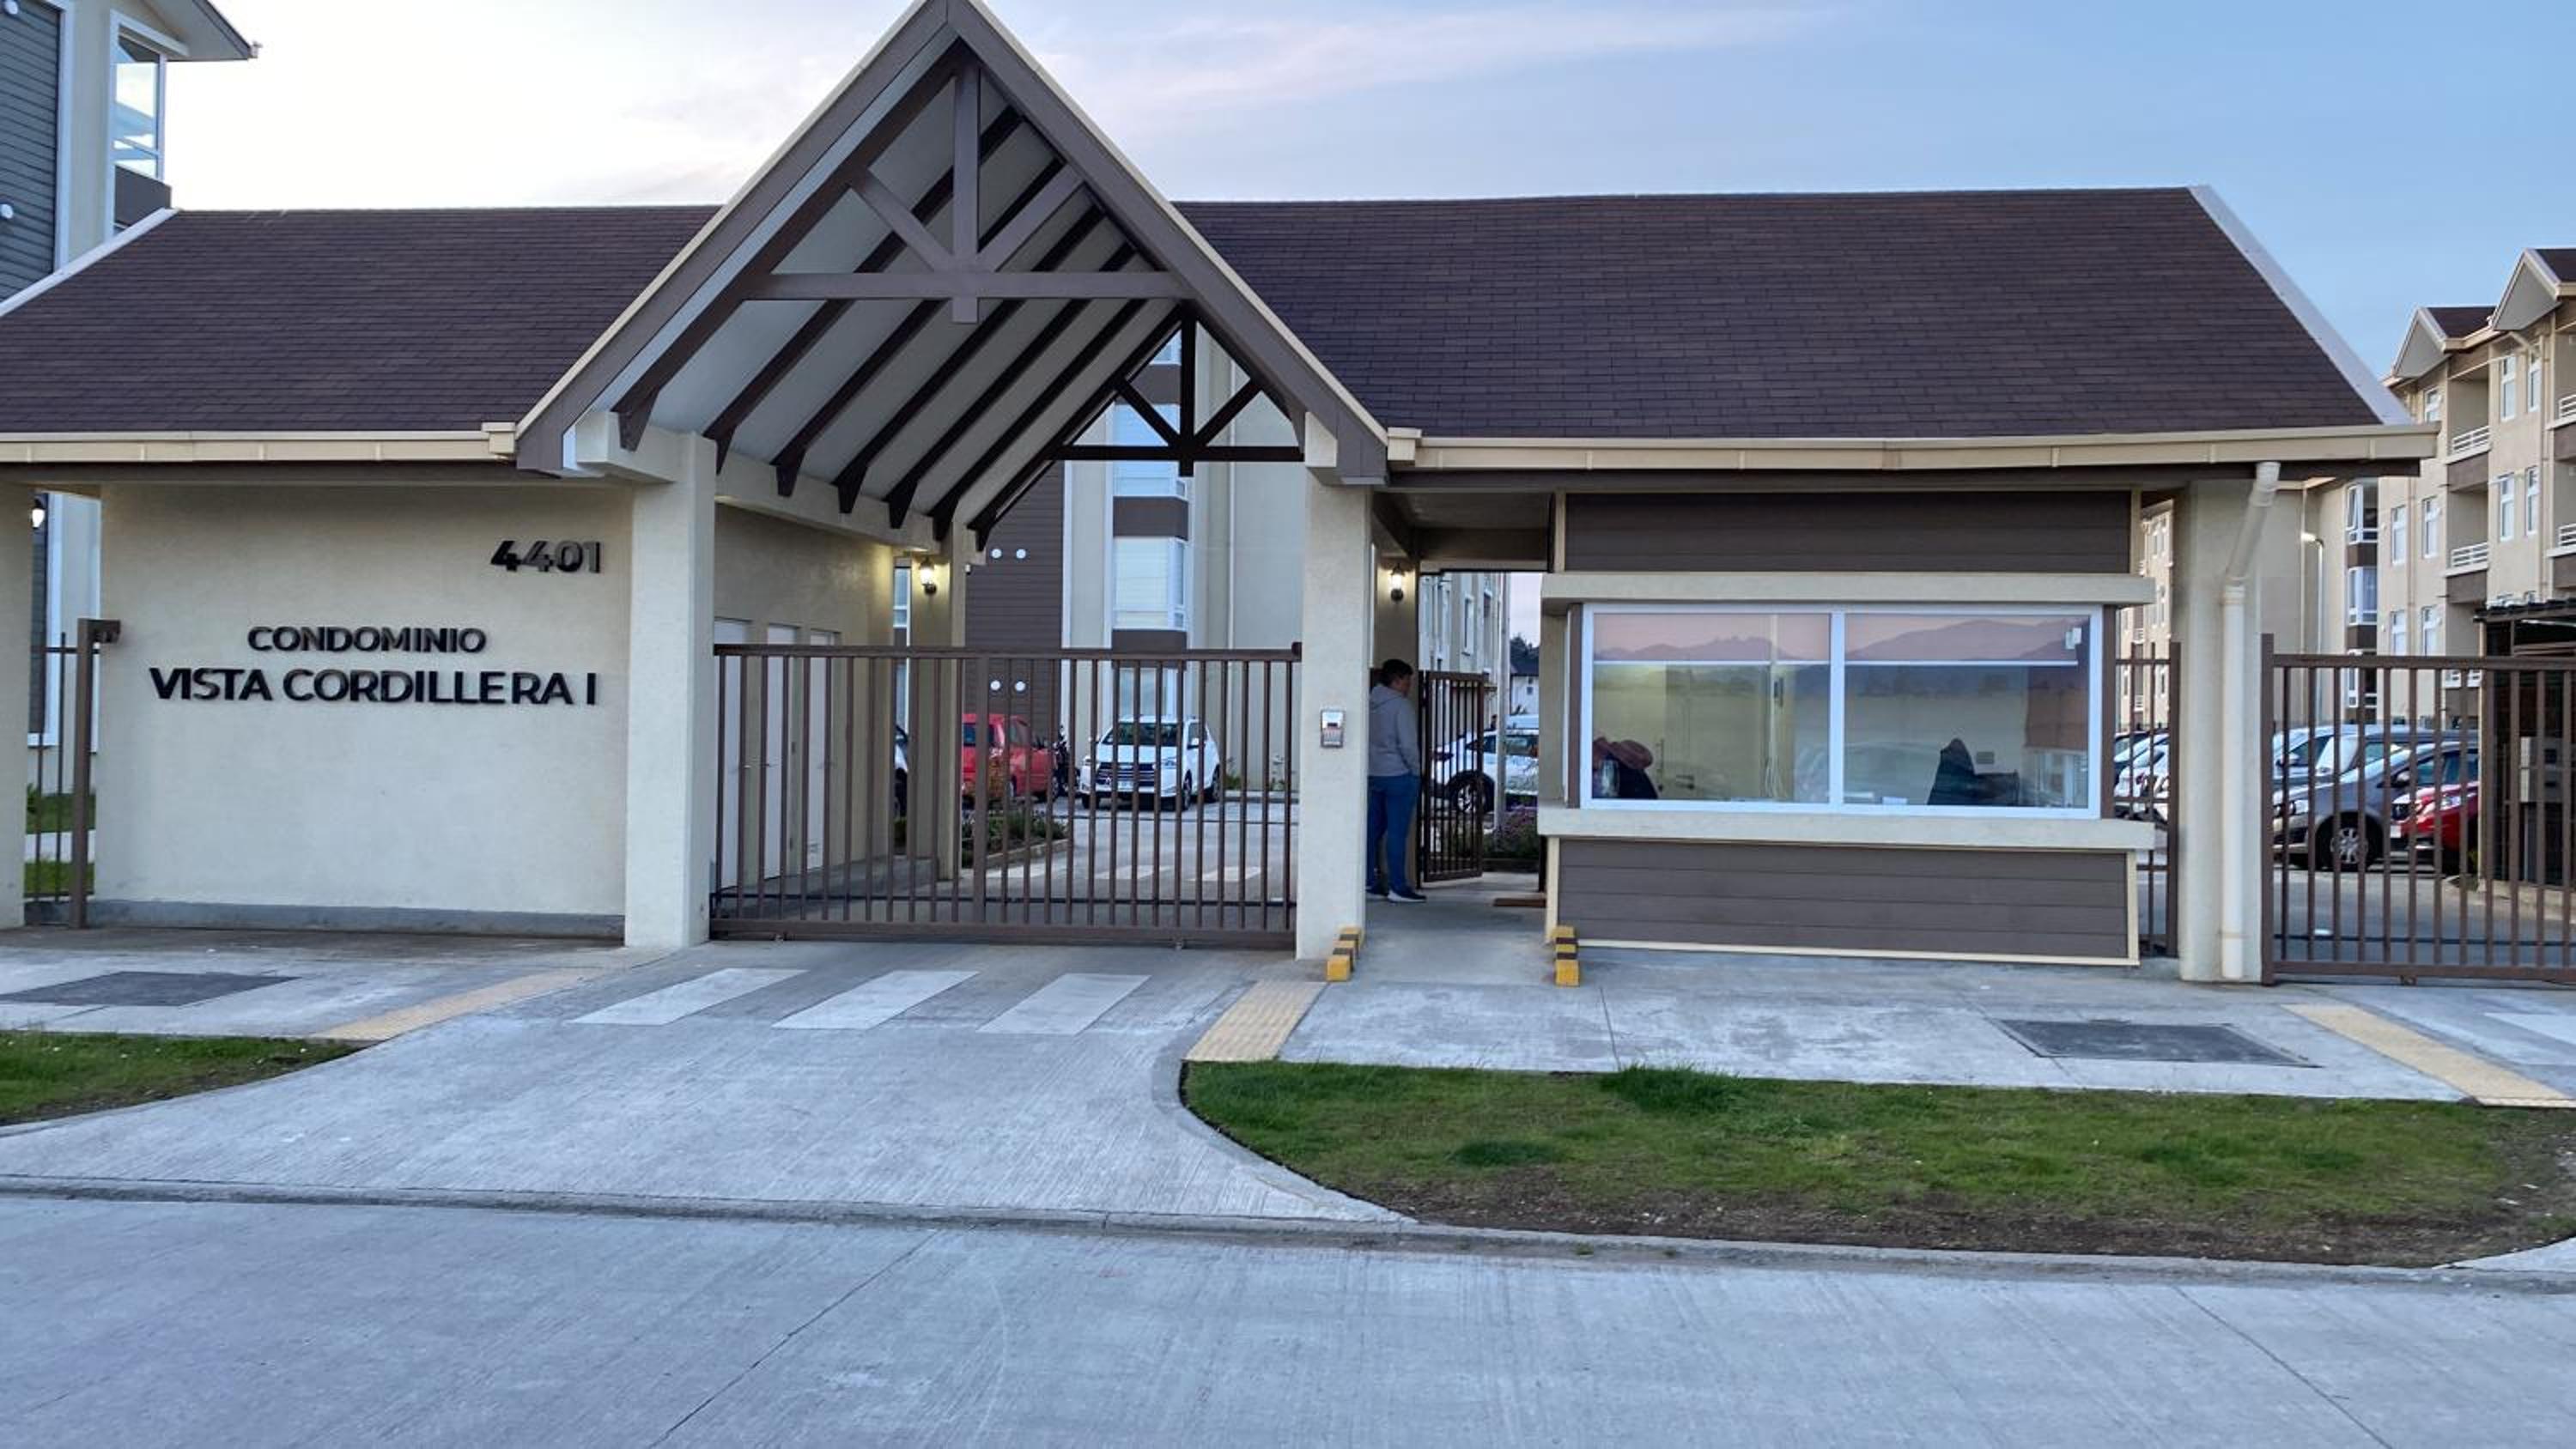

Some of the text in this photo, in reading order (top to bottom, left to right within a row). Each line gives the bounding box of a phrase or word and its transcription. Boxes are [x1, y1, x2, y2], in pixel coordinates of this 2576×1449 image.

[489, 540, 602, 574] 4401
[246, 626, 487, 653] CONDOMINIO
[149, 667, 598, 706] VISTA CORDILLERA I
